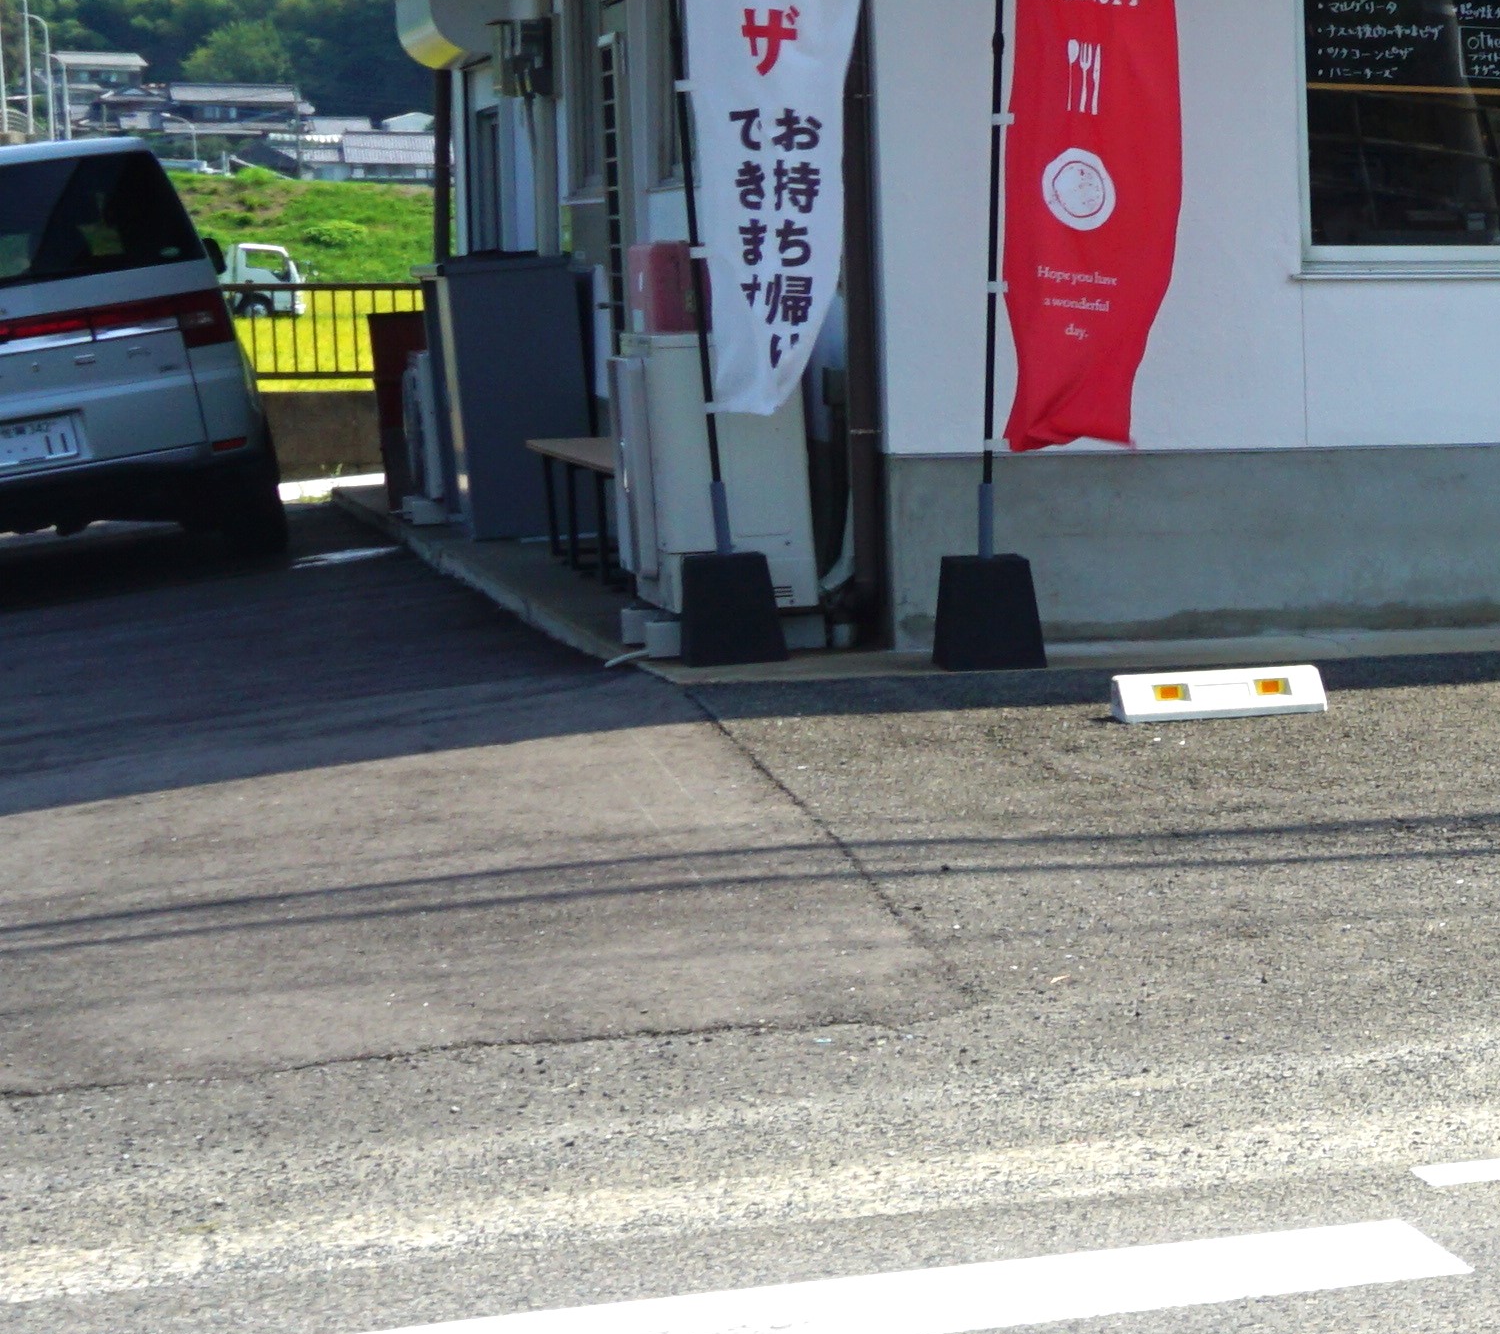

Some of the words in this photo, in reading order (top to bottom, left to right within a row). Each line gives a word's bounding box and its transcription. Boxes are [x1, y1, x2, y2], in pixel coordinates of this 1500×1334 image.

[765, 107, 823, 369] お持ち帰り
[1036, 265, 1071, 283] Hope
[1071, 273, 1093, 285] you
[1043, 297, 1051, 307] a
[1052, 296, 1109, 313] wonderful
